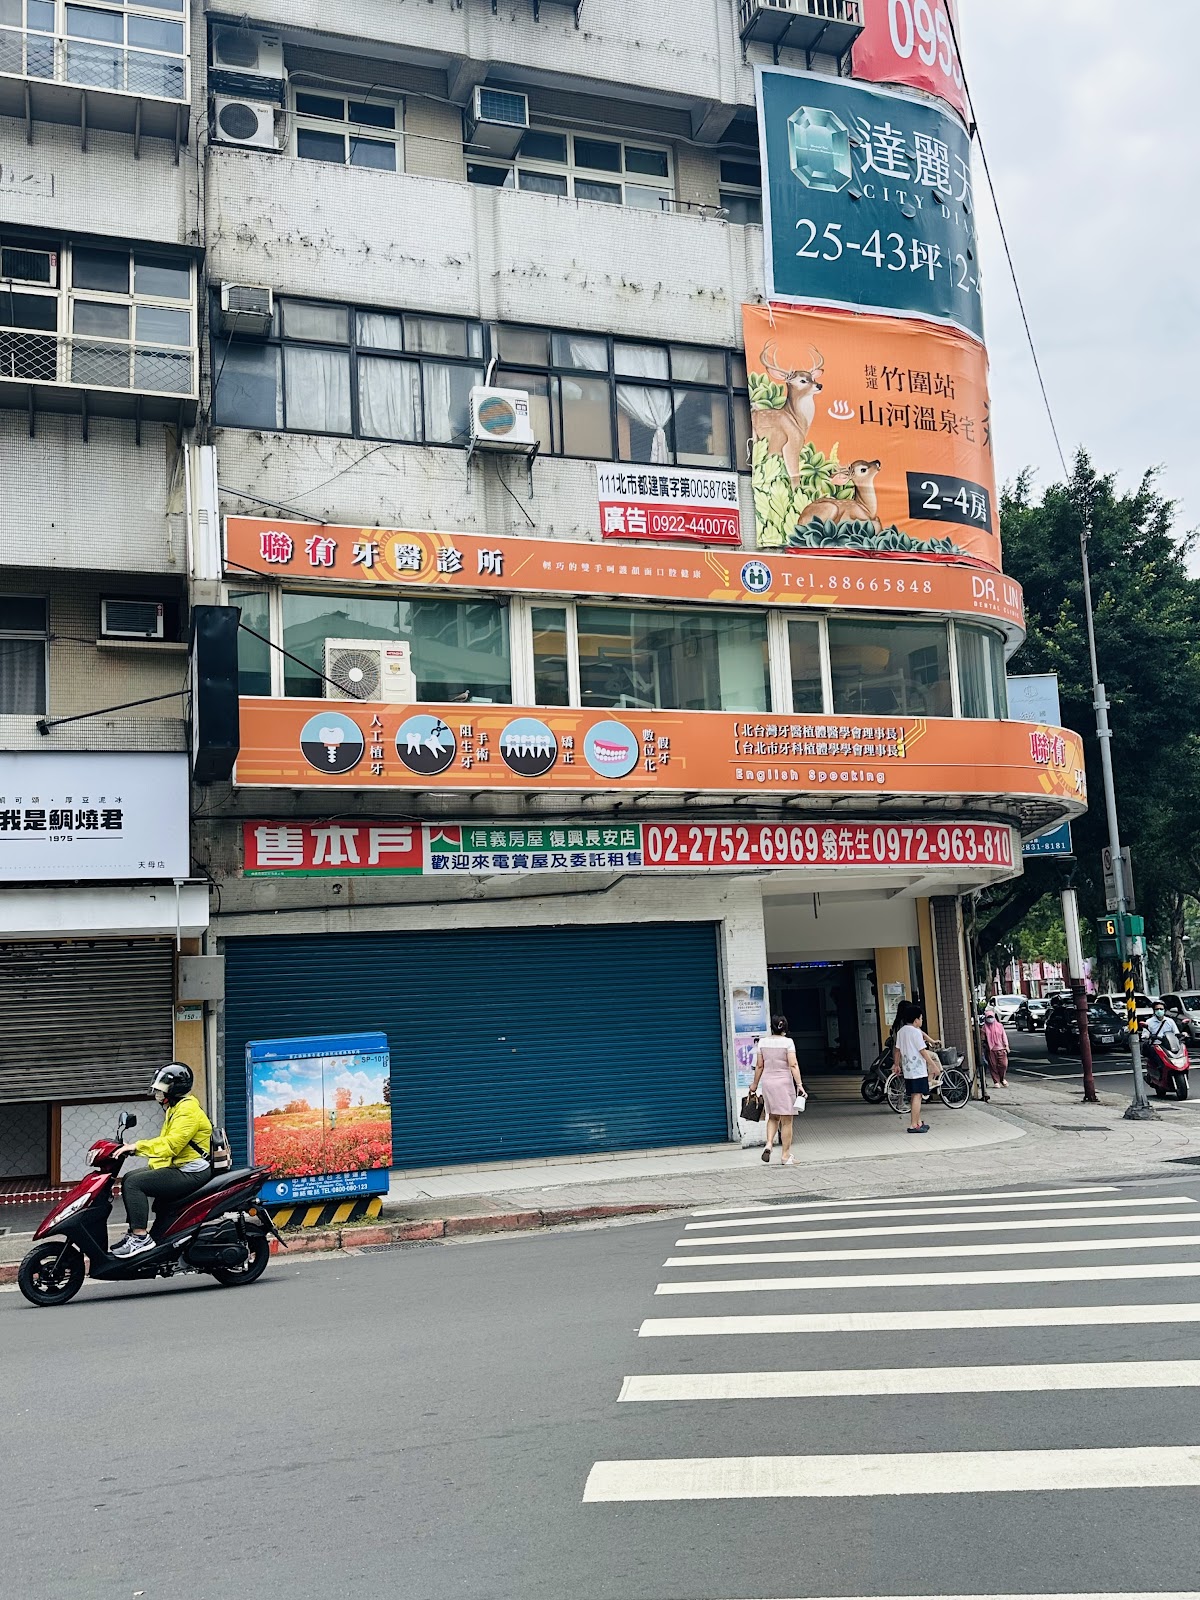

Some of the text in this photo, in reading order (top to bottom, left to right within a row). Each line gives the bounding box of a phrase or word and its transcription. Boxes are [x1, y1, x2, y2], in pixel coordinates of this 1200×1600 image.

[857, 116, 972, 203] 達麗天
[863, 185, 925, 209] CITY
[795, 219, 943, 281] 25-43坪
[864, 364, 955, 400] 捷運 竹圍站
[599, 473, 737, 502] 111北市都建廣字第005876號
[920, 481, 987, 523] 2-4房
[604, 506, 736, 536] 廣告 0922-440076
[781, 573, 932, 594] Tel.88665848
[972, 575, 1000, 602] DR.
[1003, 583, 1019, 610] LIN
[973, 601, 1000, 611] DENTAL
[369, 714, 383, 776] 人工植牙
[459, 724, 473, 769] 阻生牙
[476, 732, 489, 761] 手術
[561, 735, 574, 764] 矯正
[642, 729, 656, 772] 數位化
[657, 736, 670, 765] 假牙
[1029, 731, 1066, 767] 聯有
[735, 768, 886, 784] English Speaking
[0, 809, 124, 831] 我是鯛燒君
[254, 825, 413, 866] 售本戶
[470, 829, 635, 848] 信義房屋 復興長安店
[138, 861, 165, 869] 天母店
[431, 852, 642, 870] 歡迎來電賞屋及委託租售
[1107, 920, 1115, 935] 6
